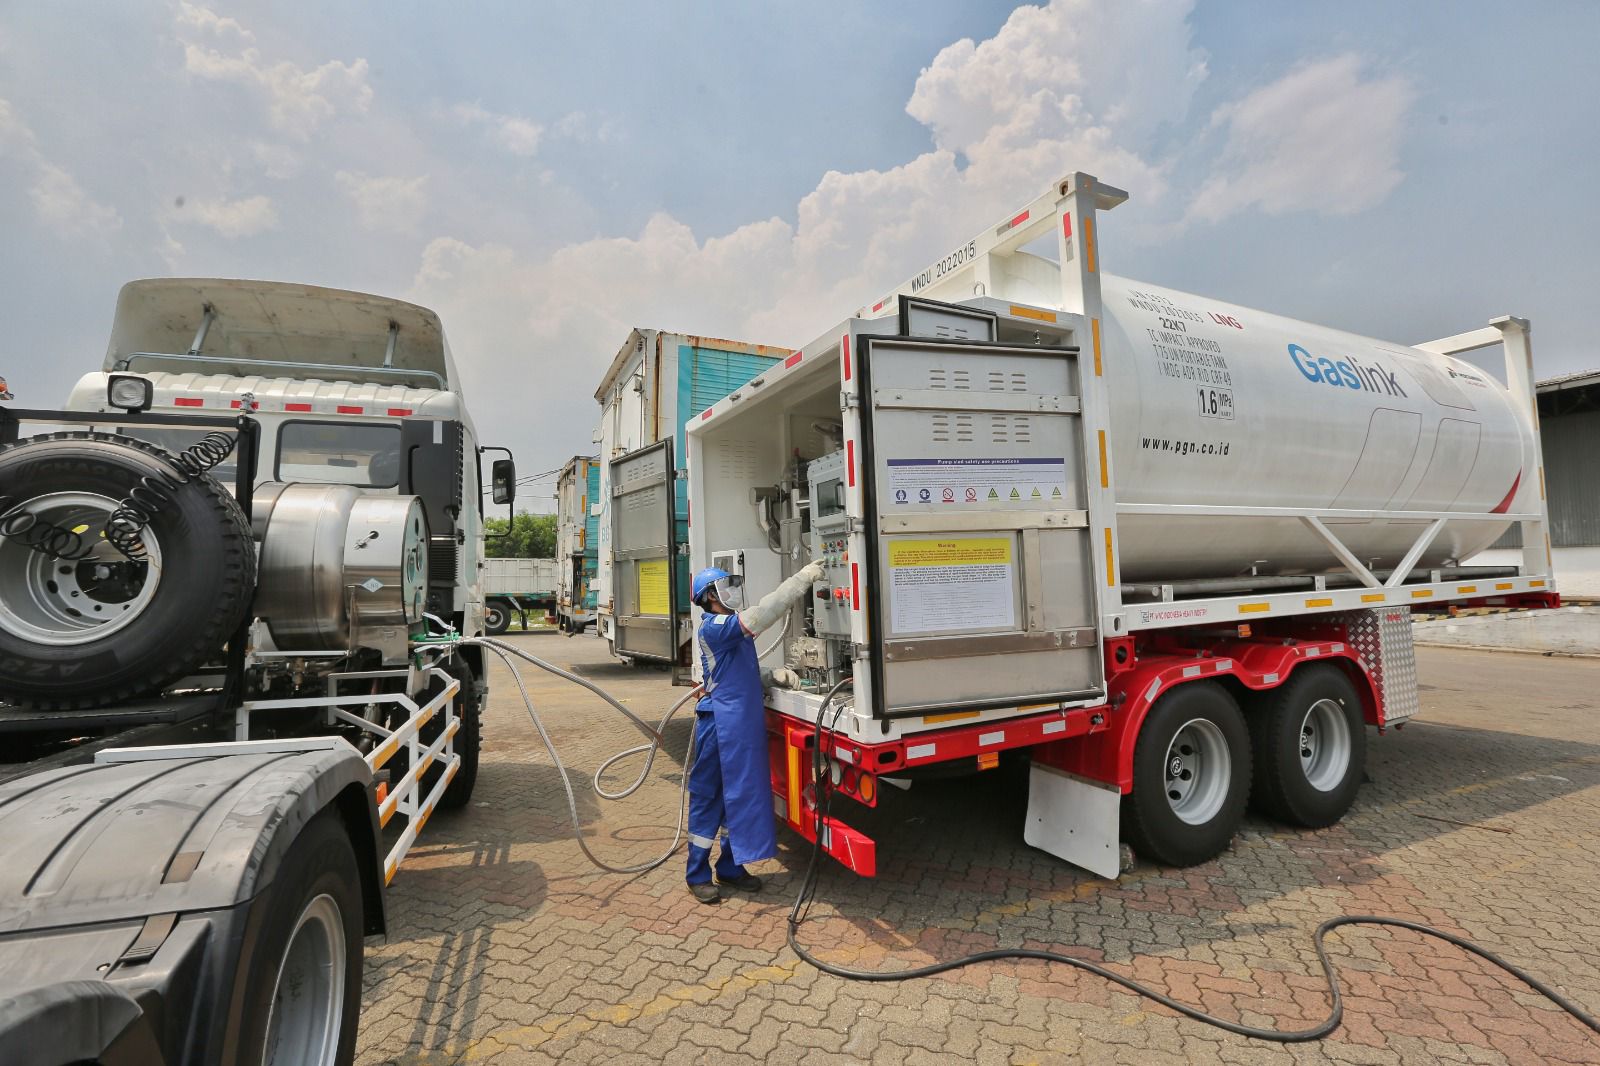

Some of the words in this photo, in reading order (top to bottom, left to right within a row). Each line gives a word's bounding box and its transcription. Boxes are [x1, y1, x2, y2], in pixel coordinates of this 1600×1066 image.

[911, 269, 931, 293] WNDU
[936, 241, 976, 278] 2022015
[1126, 297, 1161, 313] WNDU
[1161, 305, 1204, 323] 2022015
[1207, 311, 1244, 330] LNG
[1158, 316, 1187, 333] 22K7
[1146, 328, 1159, 342] TC
[1158, 330, 1186, 347] IMPACT
[1186, 336, 1221, 353] APPROVED
[1287, 343, 1409, 399] Gaslink
[1199, 389, 1218, 415] 1.6
[1219, 393, 1232, 408] MPa
[1142, 437, 1230, 456] www.pgn.co.id
